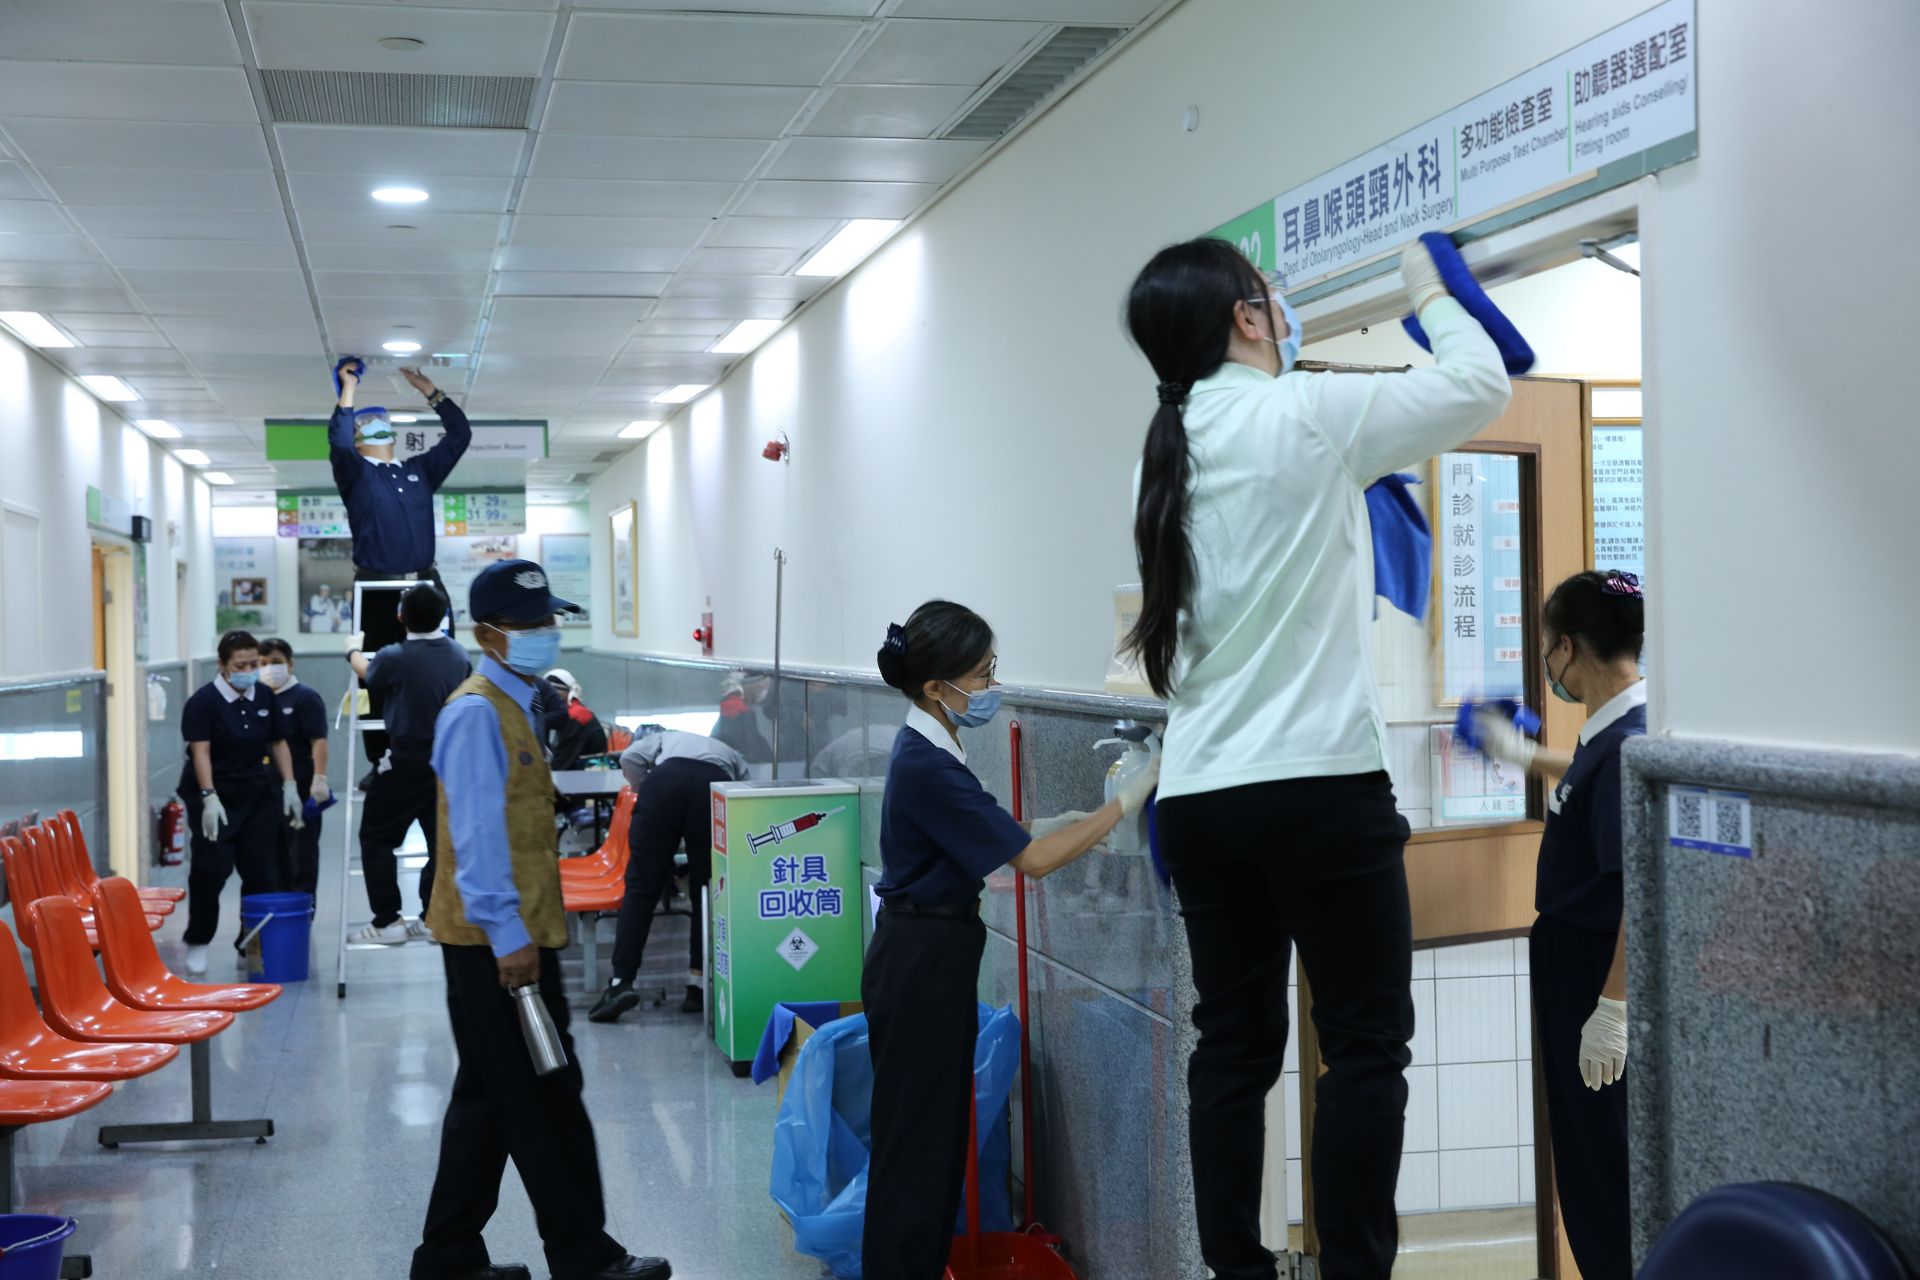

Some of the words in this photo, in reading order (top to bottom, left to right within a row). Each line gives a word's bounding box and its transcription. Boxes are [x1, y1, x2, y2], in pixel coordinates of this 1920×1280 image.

[1574, 22, 1688, 106] 助聽器選配室
[1460, 87, 1553, 159] 多功能檢查室
[1575, 111, 1609, 135] Hearing
[1611, 99, 1631, 120] aids
[1575, 138, 1604, 158] Fitting
[1605, 127, 1630, 147] room
[1460, 162, 1479, 182] Multi
[1513, 142, 1530, 160] Test
[1531, 127, 1569, 152] Chamber
[1282, 137, 1441, 254] 耳鼻喉頭頸外科
[1302, 254, 1309, 269] of
[1384, 221, 1399, 239] and
[1400, 211, 1420, 230] Neck
[1421, 197, 1455, 221] Surgery
[1452, 463, 1477, 639] 門診就診流程
[771, 856, 828, 884] 針具
[760, 888, 842, 918] 回收筒
